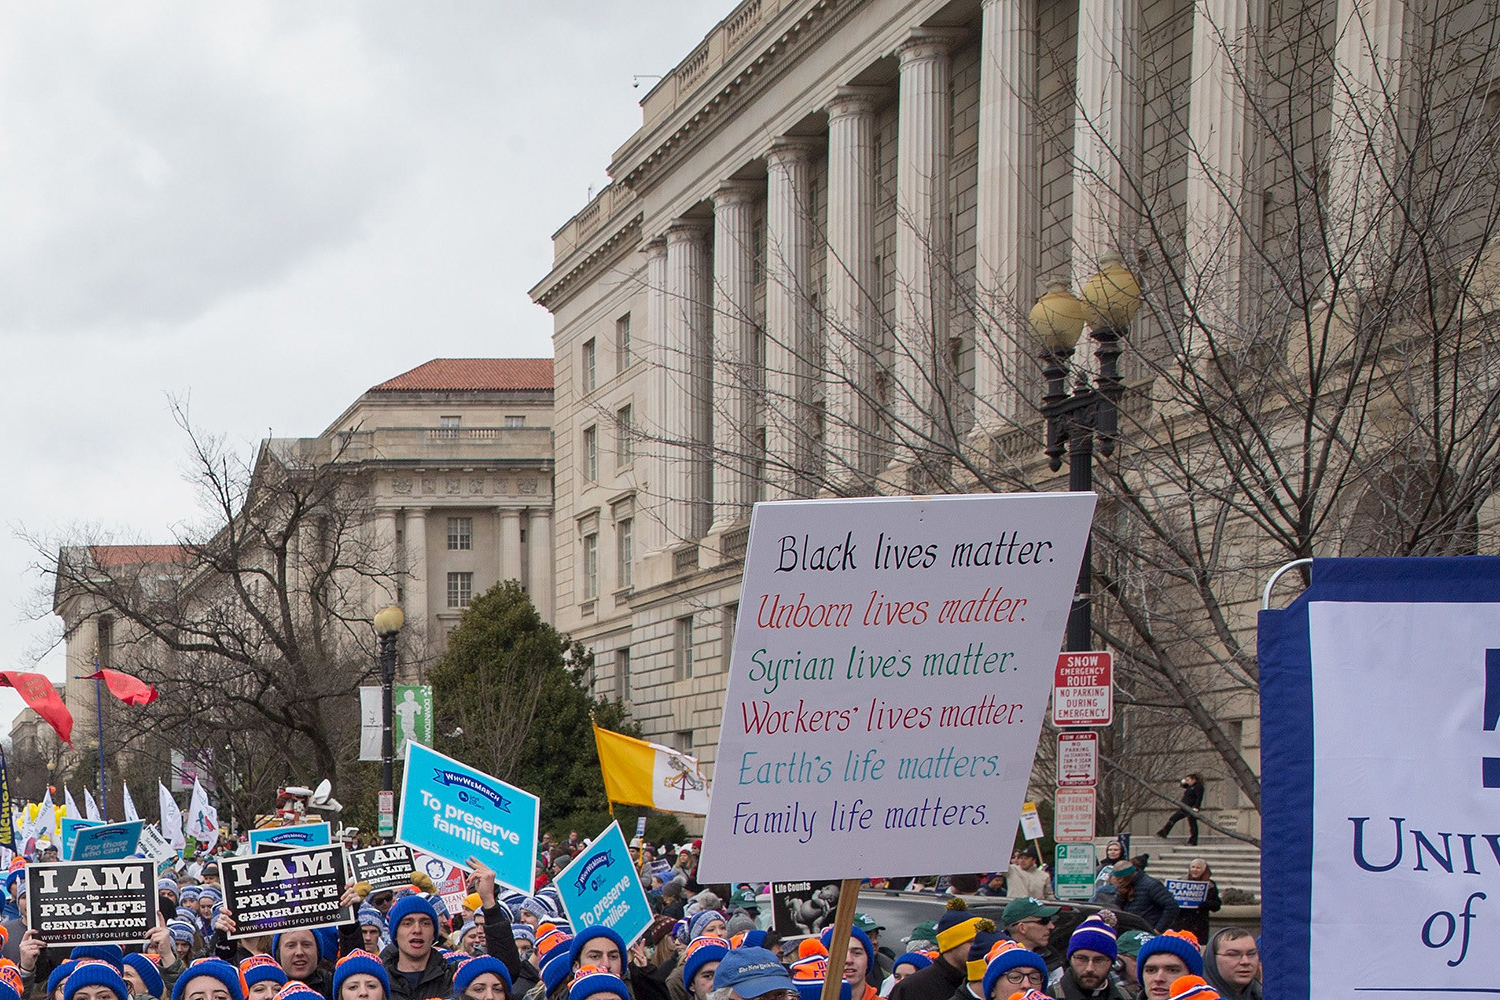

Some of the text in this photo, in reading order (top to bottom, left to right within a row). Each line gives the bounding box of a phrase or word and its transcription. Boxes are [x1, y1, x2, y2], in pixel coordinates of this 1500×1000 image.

[774, 531, 1054, 573] Black lives matter.
[757, 587, 1027, 629] Unborn lives matter.
[748, 642, 1018, 694] Syrian lives matter.
[1060, 667, 1105, 676] EMERGENCY
[1067, 656, 1098, 667] SNOW
[1067, 676, 1098, 686] ROUTE
[1060, 688, 1105, 697] NO PARKING
[1058, 708, 1106, 718] EMERGENCY
[1066, 699, 1098, 707] DURING
[867, 698, 931, 732] lives
[940, 695, 1024, 728] matter.
[738, 747, 1001, 785] Earth's life matters.
[420, 789, 441, 811] To
[444, 803, 520, 845] preserve
[733, 798, 989, 844] Family life matters.
[432, 814, 503, 856] families.
[82, 850, 101, 858] who
[85, 844, 100, 853] For
[102, 840, 128, 851] those
[1058, 846, 1066, 857] 2
[356, 853, 367, 867] I
[372, 847, 409, 864] AM
[232, 851, 335, 887] I AM
[360, 864, 412, 880] PRO-LIFE
[364, 873, 412, 885] ENERATION
[39, 866, 145, 894] I AM
[774, 881, 812, 894] Life Counts
[1169, 882, 1205, 890] DEFUND
[235, 884, 338, 909] PRO-LIFE
[580, 875, 630, 928] To preserve
[40, 900, 147, 917] PRO-LIFE
[238, 901, 340, 922] GENERATION
[602, 900, 631, 928] milies.
[41, 917, 147, 931] GENERATION
[1420, 891, 1488, 967] of
